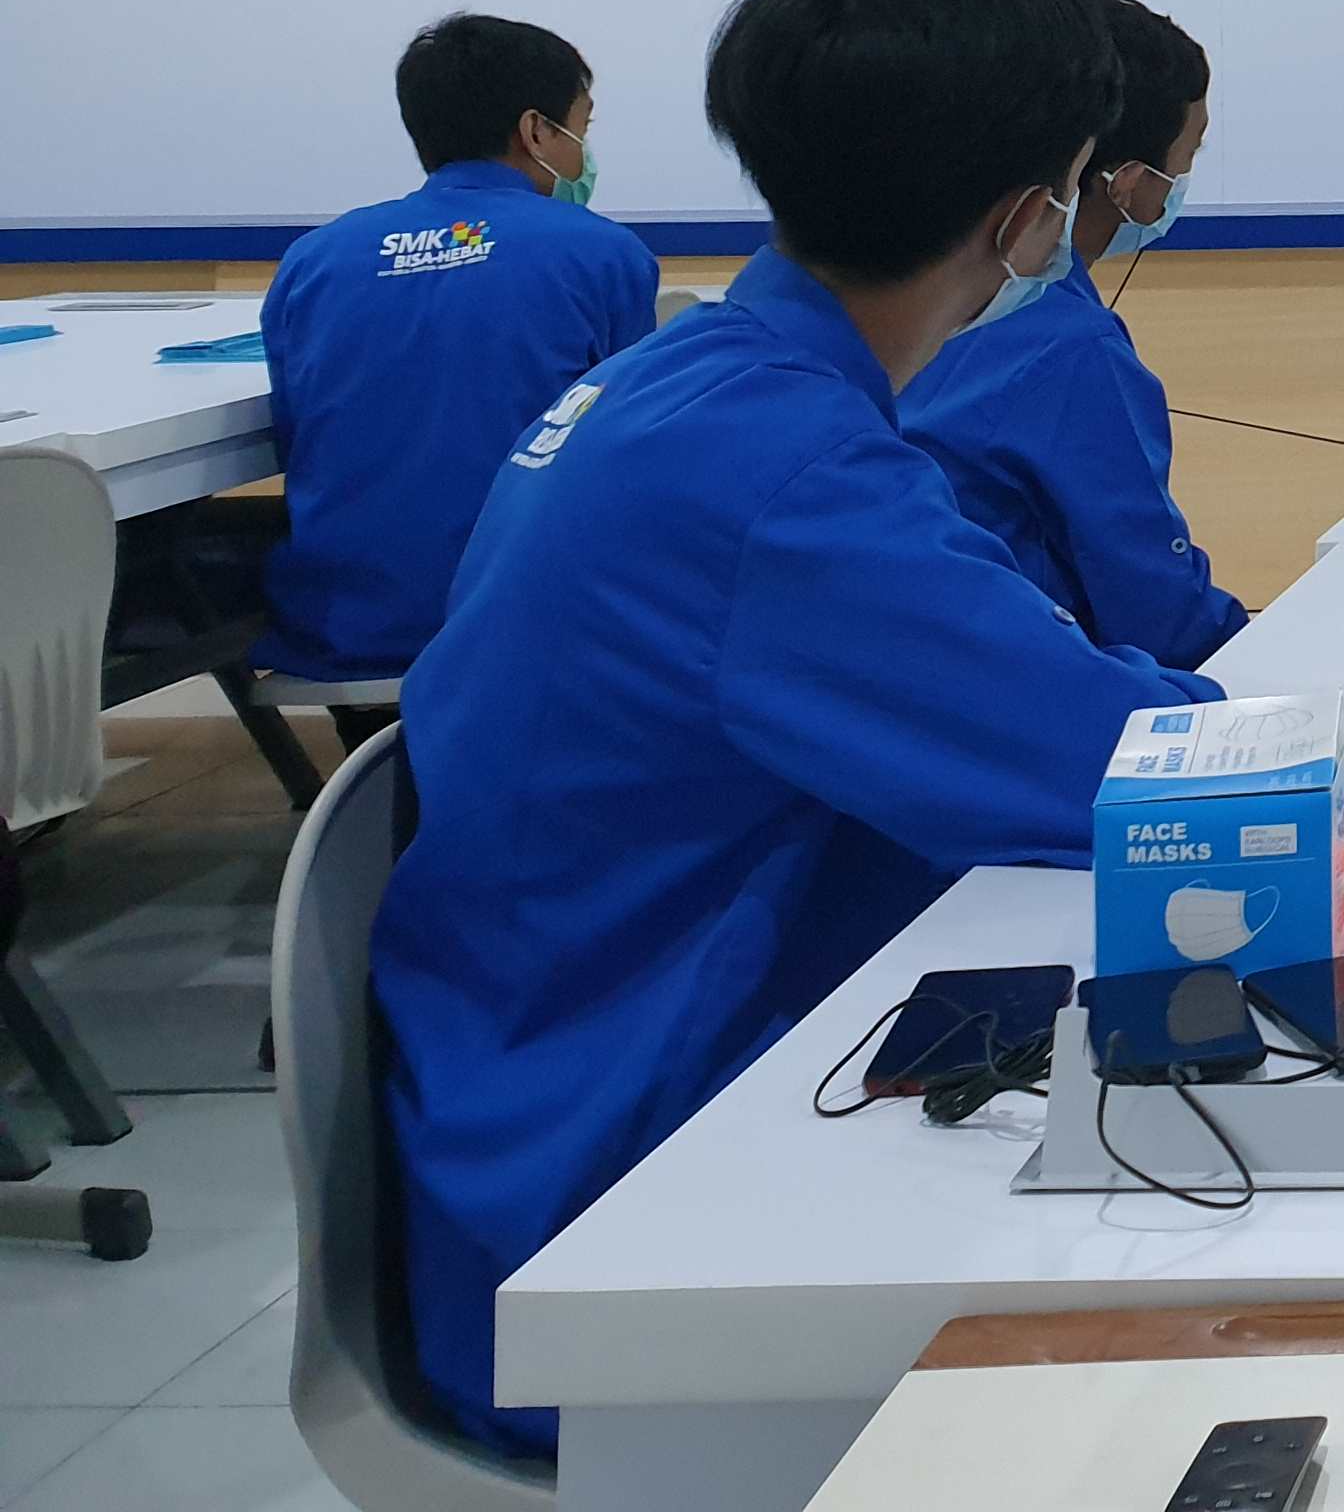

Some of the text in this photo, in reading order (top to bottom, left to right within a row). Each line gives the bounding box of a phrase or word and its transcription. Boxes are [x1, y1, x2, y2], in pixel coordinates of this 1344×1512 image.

[379, 228, 448, 256] SMK
[393, 241, 496, 269] BISA-HEBAT
[1127, 822, 1188, 842] FACE
[1126, 843, 1212, 864] MASKS
